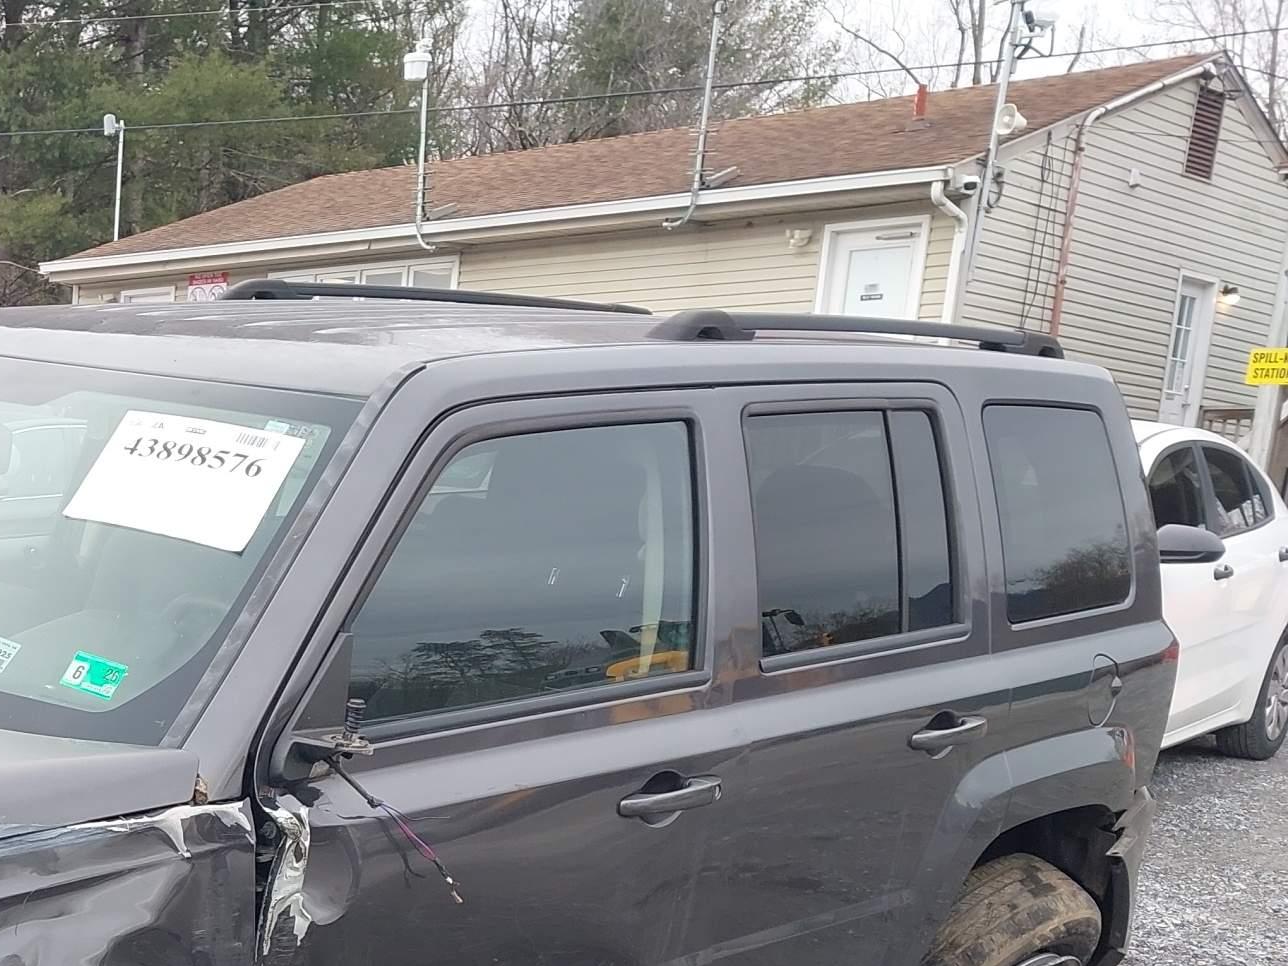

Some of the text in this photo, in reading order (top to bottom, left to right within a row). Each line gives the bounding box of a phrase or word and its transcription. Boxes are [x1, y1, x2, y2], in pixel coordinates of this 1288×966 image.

[1252, 367, 1288, 379] STATIO
[123, 436, 267, 478] 43898576
[72, 665, 85, 680] 6
